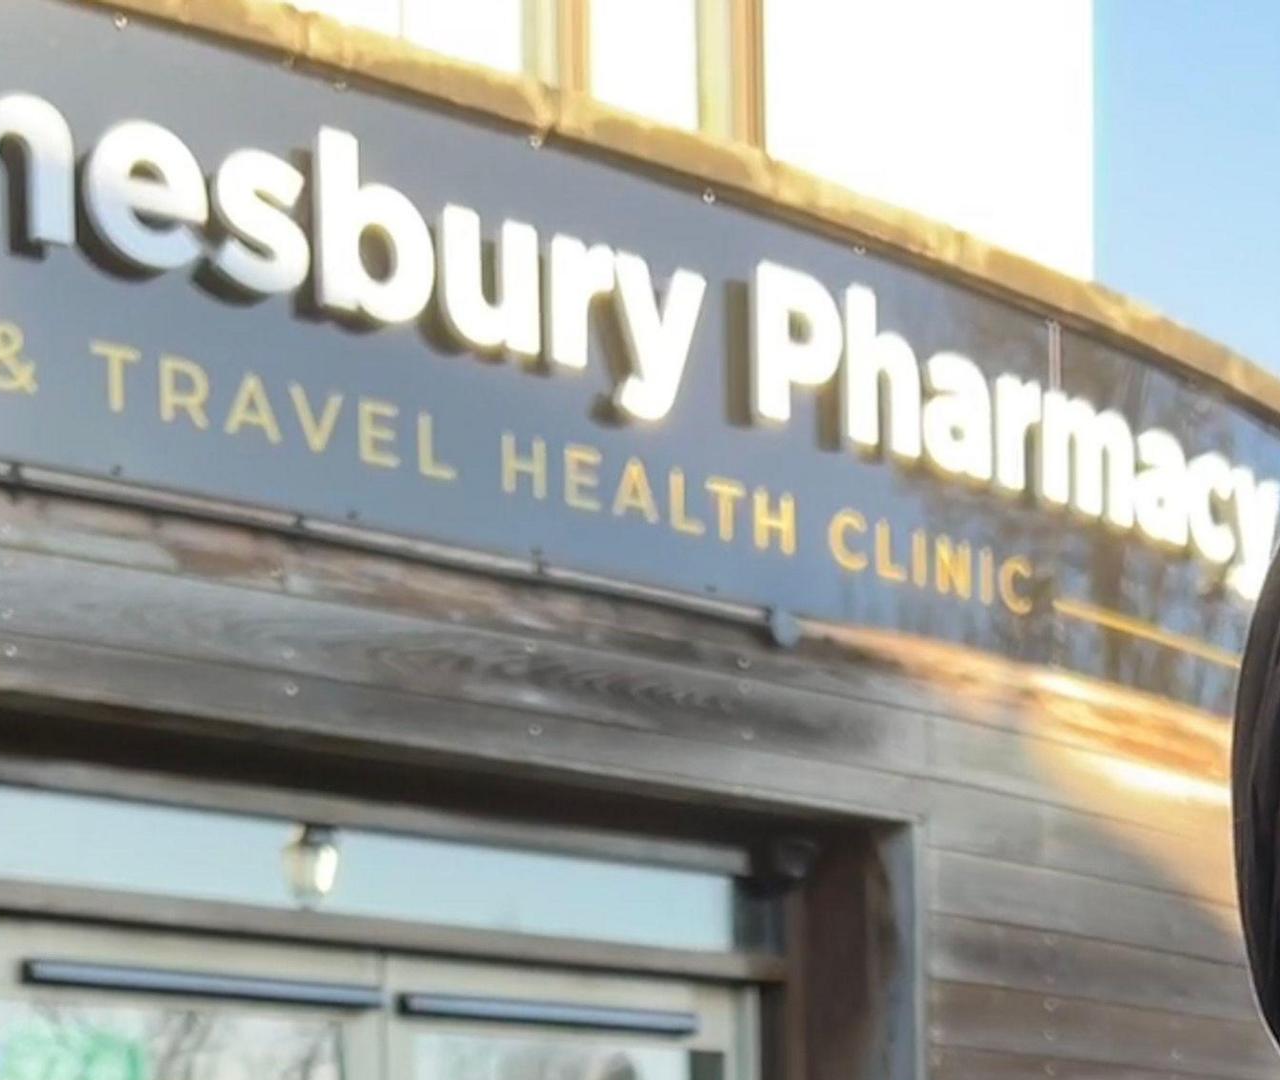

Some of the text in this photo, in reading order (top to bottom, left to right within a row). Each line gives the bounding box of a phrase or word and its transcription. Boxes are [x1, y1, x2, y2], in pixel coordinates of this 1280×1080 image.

[90, 340, 458, 482] TRAVEL
[501, 429, 797, 557] HEALTH
[827, 507, 1035, 617] CLINIC
[756, 258, 1280, 602] Pharmacy
